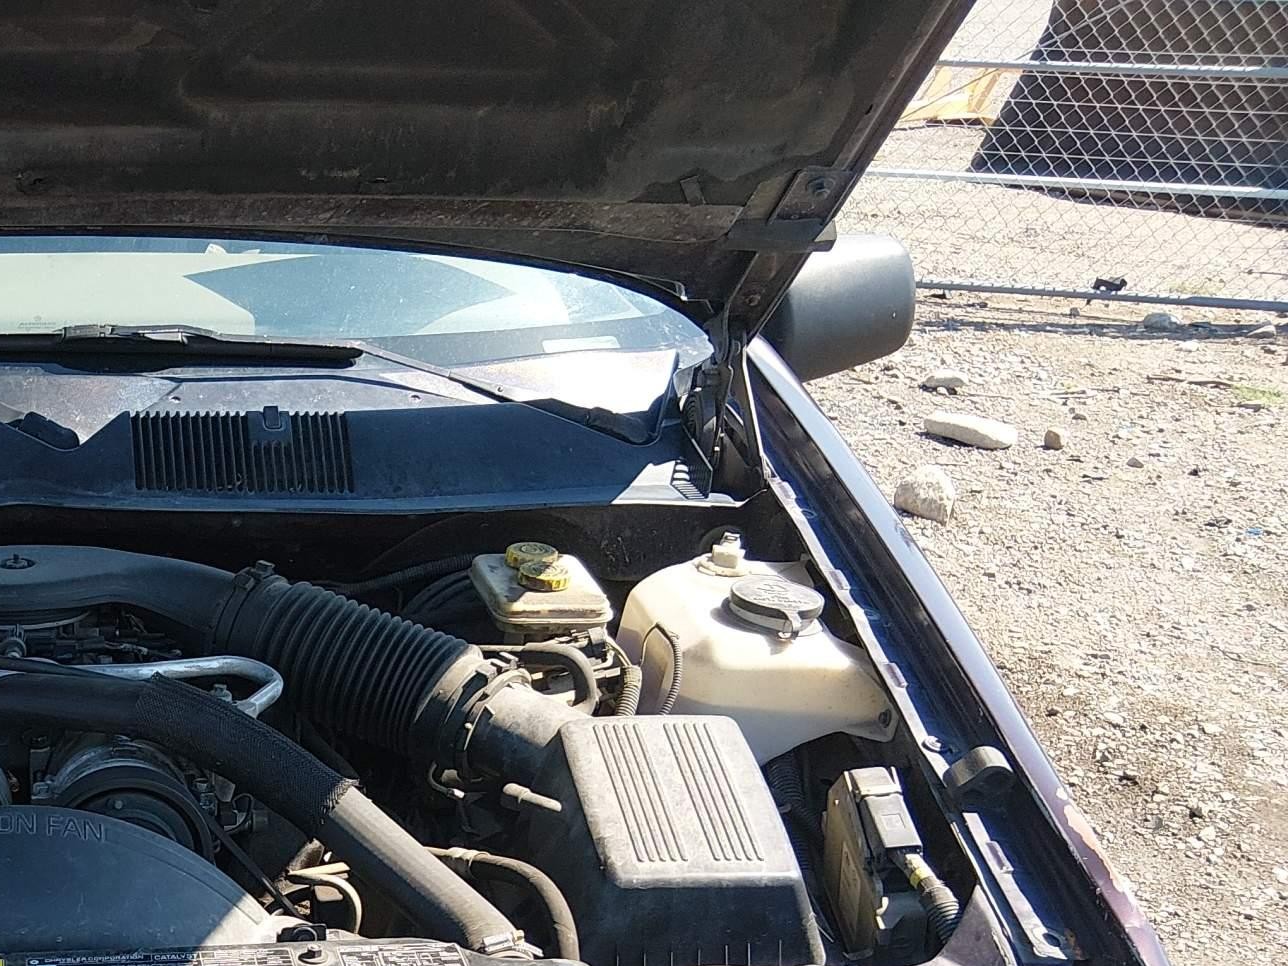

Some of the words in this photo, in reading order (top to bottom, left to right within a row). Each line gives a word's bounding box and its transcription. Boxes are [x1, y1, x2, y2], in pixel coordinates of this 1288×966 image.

[46, 815, 105, 843] FAN
[88, 953, 145, 961] CORPORATION
[154, 953, 197, 961] CATALYST
